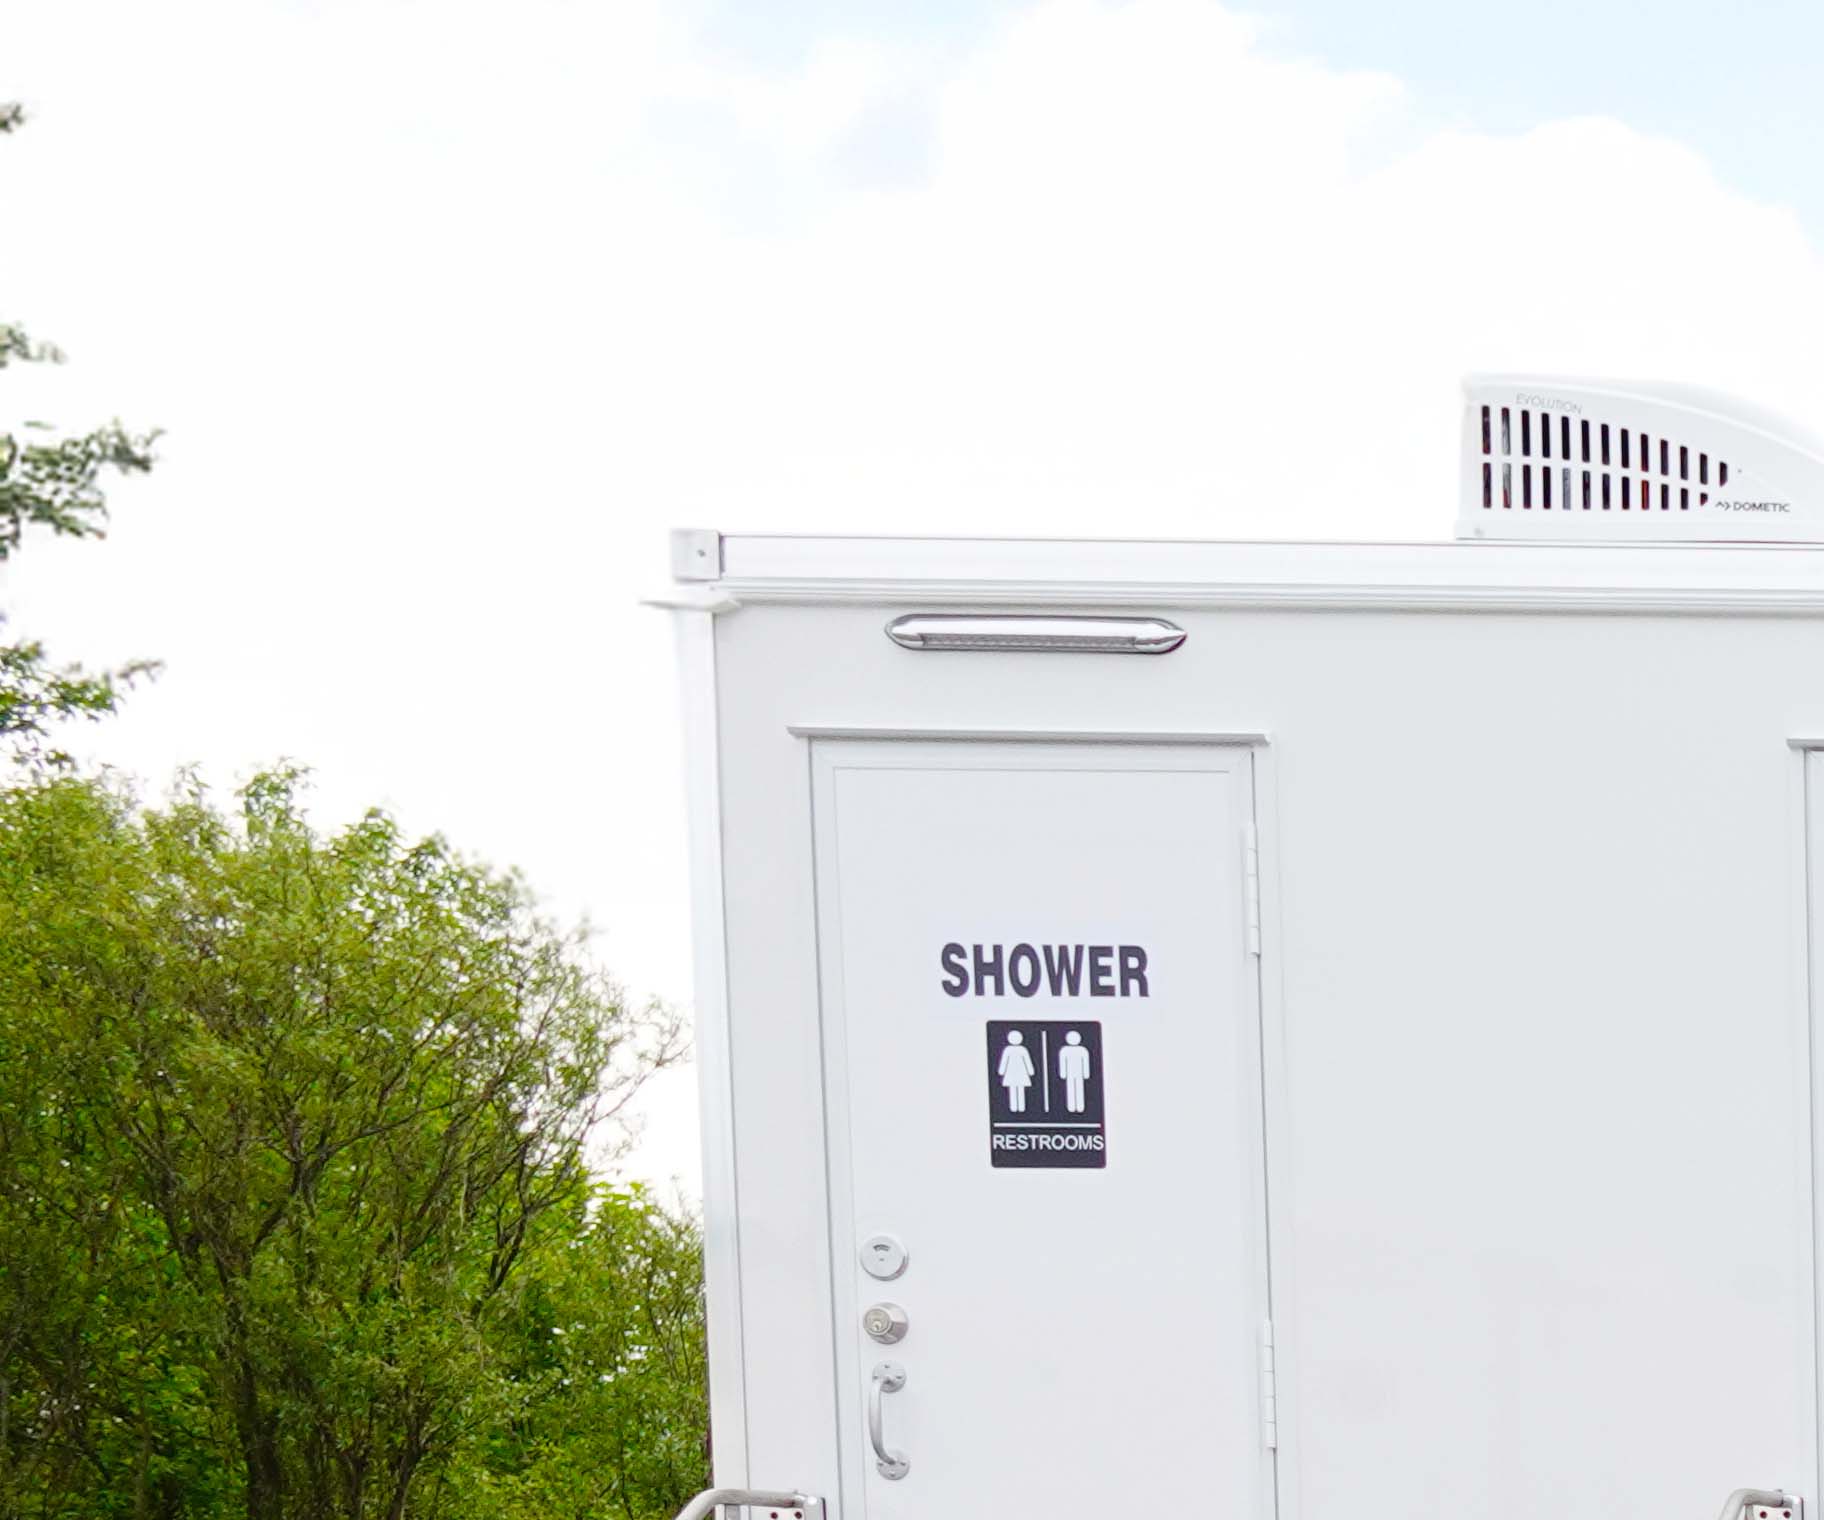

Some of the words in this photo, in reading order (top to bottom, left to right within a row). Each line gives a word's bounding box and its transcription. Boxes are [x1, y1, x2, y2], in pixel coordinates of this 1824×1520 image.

[1733, 502, 1791, 513] DOMETIC
[941, 942, 1149, 998] SHOWER
[993, 1134, 1104, 1150] RESTROOMS
